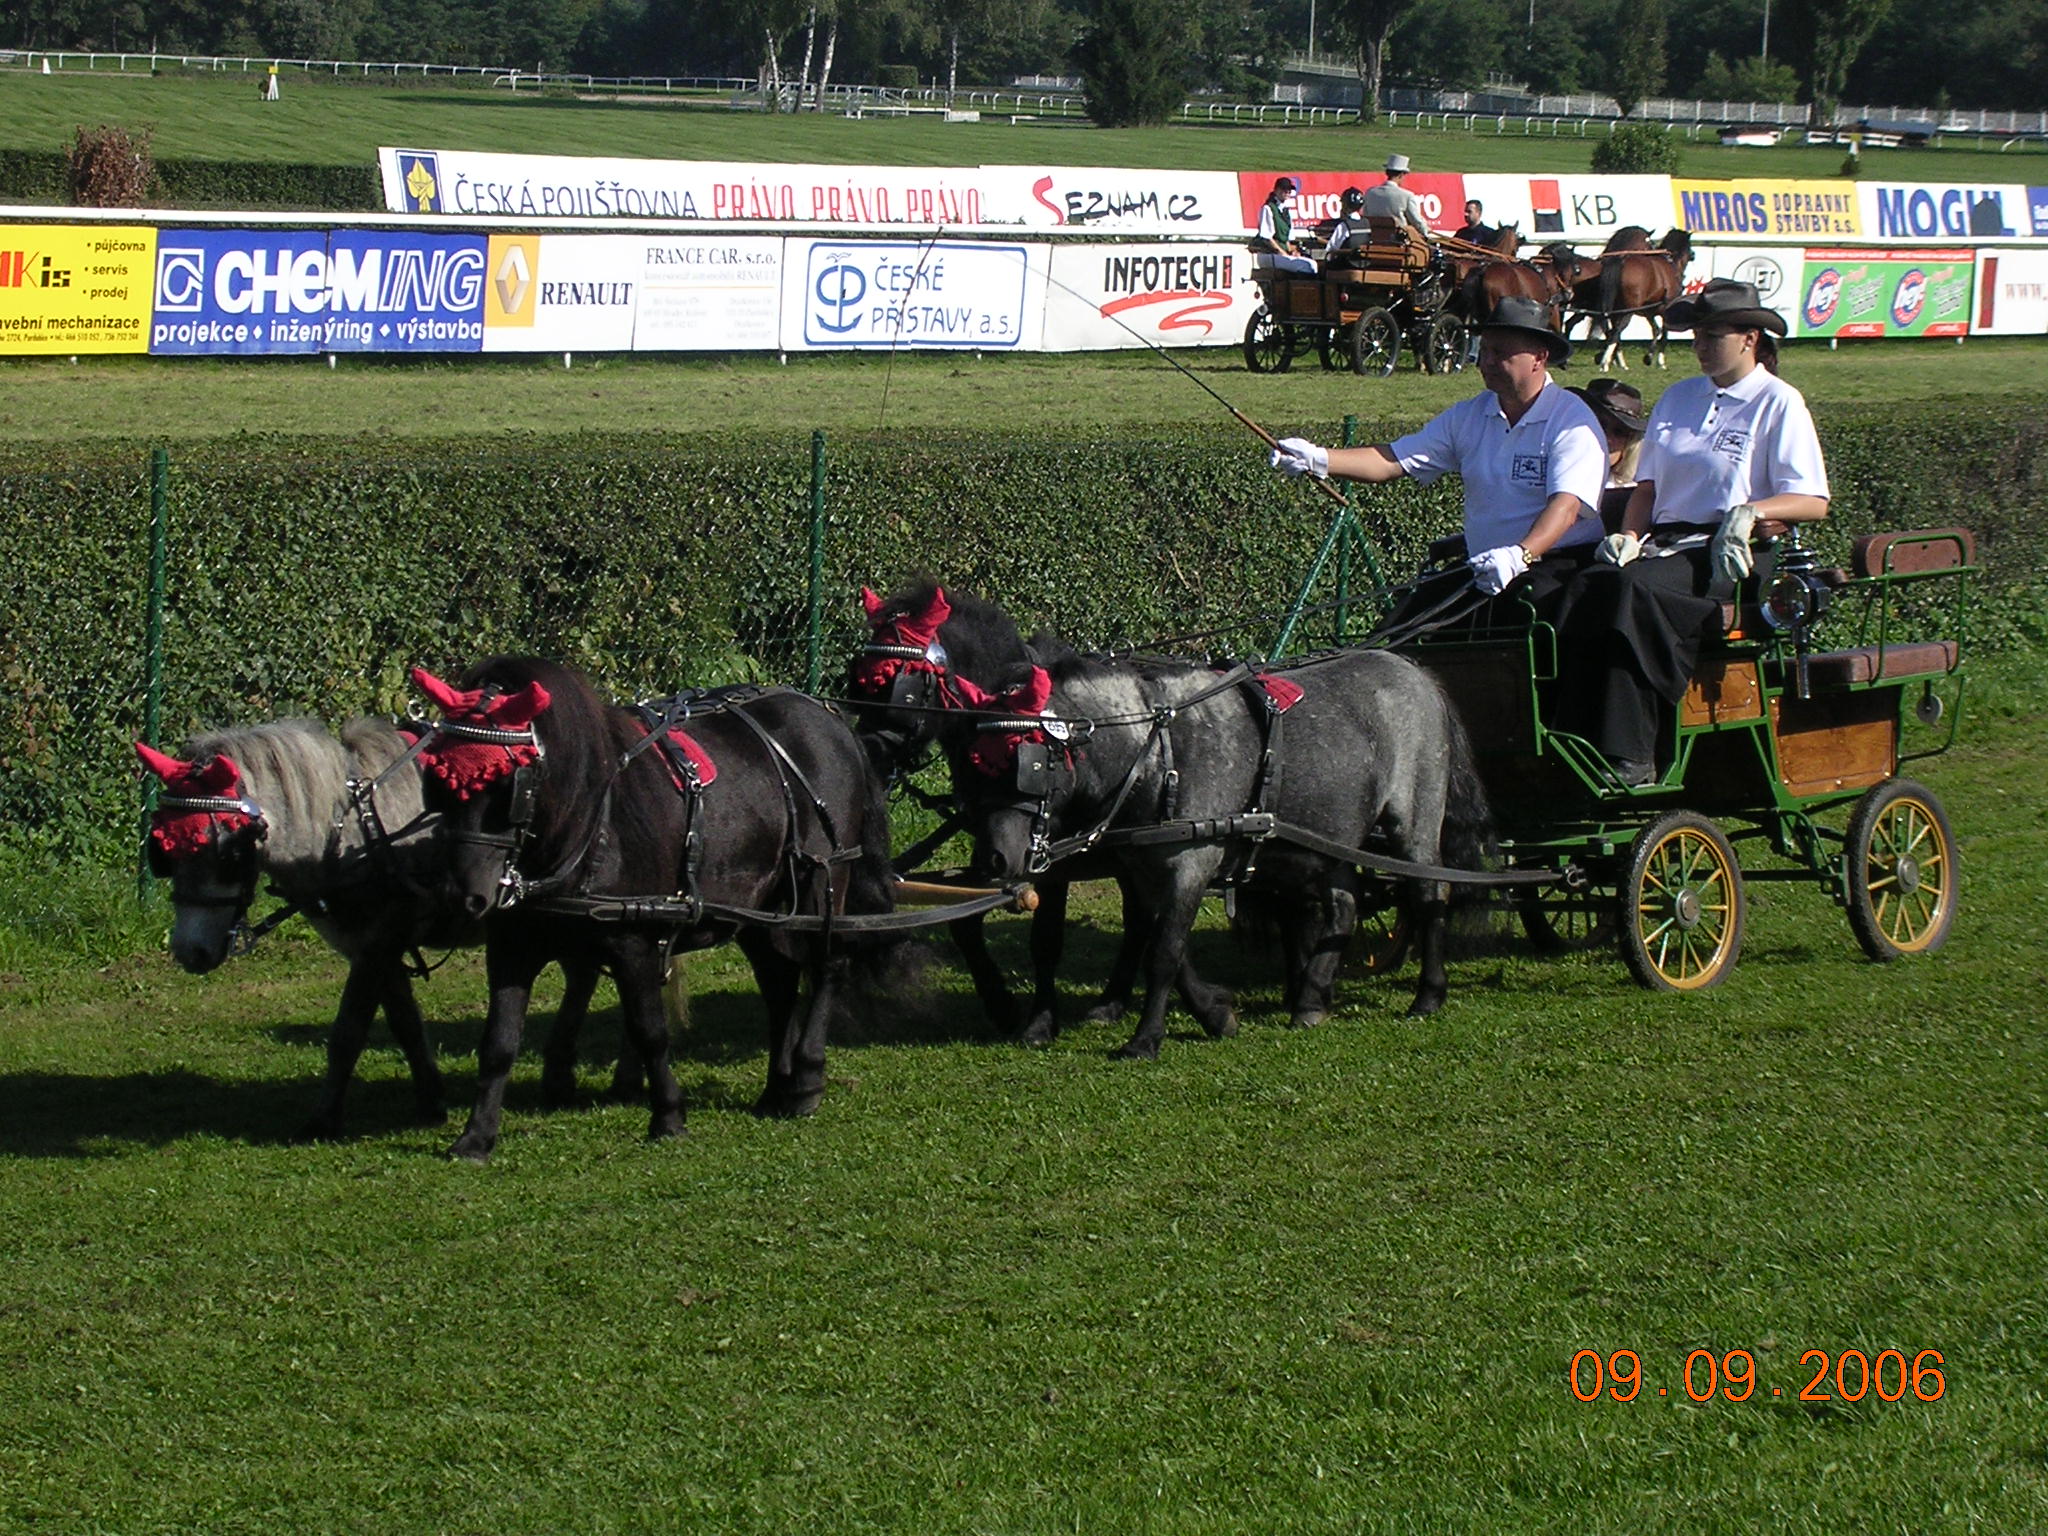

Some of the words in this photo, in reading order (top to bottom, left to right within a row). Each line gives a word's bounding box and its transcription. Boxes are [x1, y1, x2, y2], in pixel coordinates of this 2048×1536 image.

[455, 172, 537, 216] ČESKÁ
[713, 176, 795, 220] PRÁVO
[812, 179, 889, 223] PRÁVO
[907, 181, 982, 224] PRÁVO
[1572, 194, 1617, 226] KB
[1681, 191, 1768, 233] MIROS
[95, 239, 146, 254] půjčovna
[646, 248, 705, 265] FRANCE
[746, 253, 777, 265] s.r.o.
[92, 264, 129, 276] servis
[875, 257, 944, 291] ČESKÉ
[1104, 256, 1218, 295] INFOTECH
[90, 287, 129, 300] prodej
[541, 282, 633, 305] RENAULT
[47, 315, 140, 329] mechanizace
[154, 321, 248, 346] projekce
[271, 317, 373, 344] inženýring
[397, 317, 482, 344] výstavba
[980, 315, 1013, 334] a.s.
